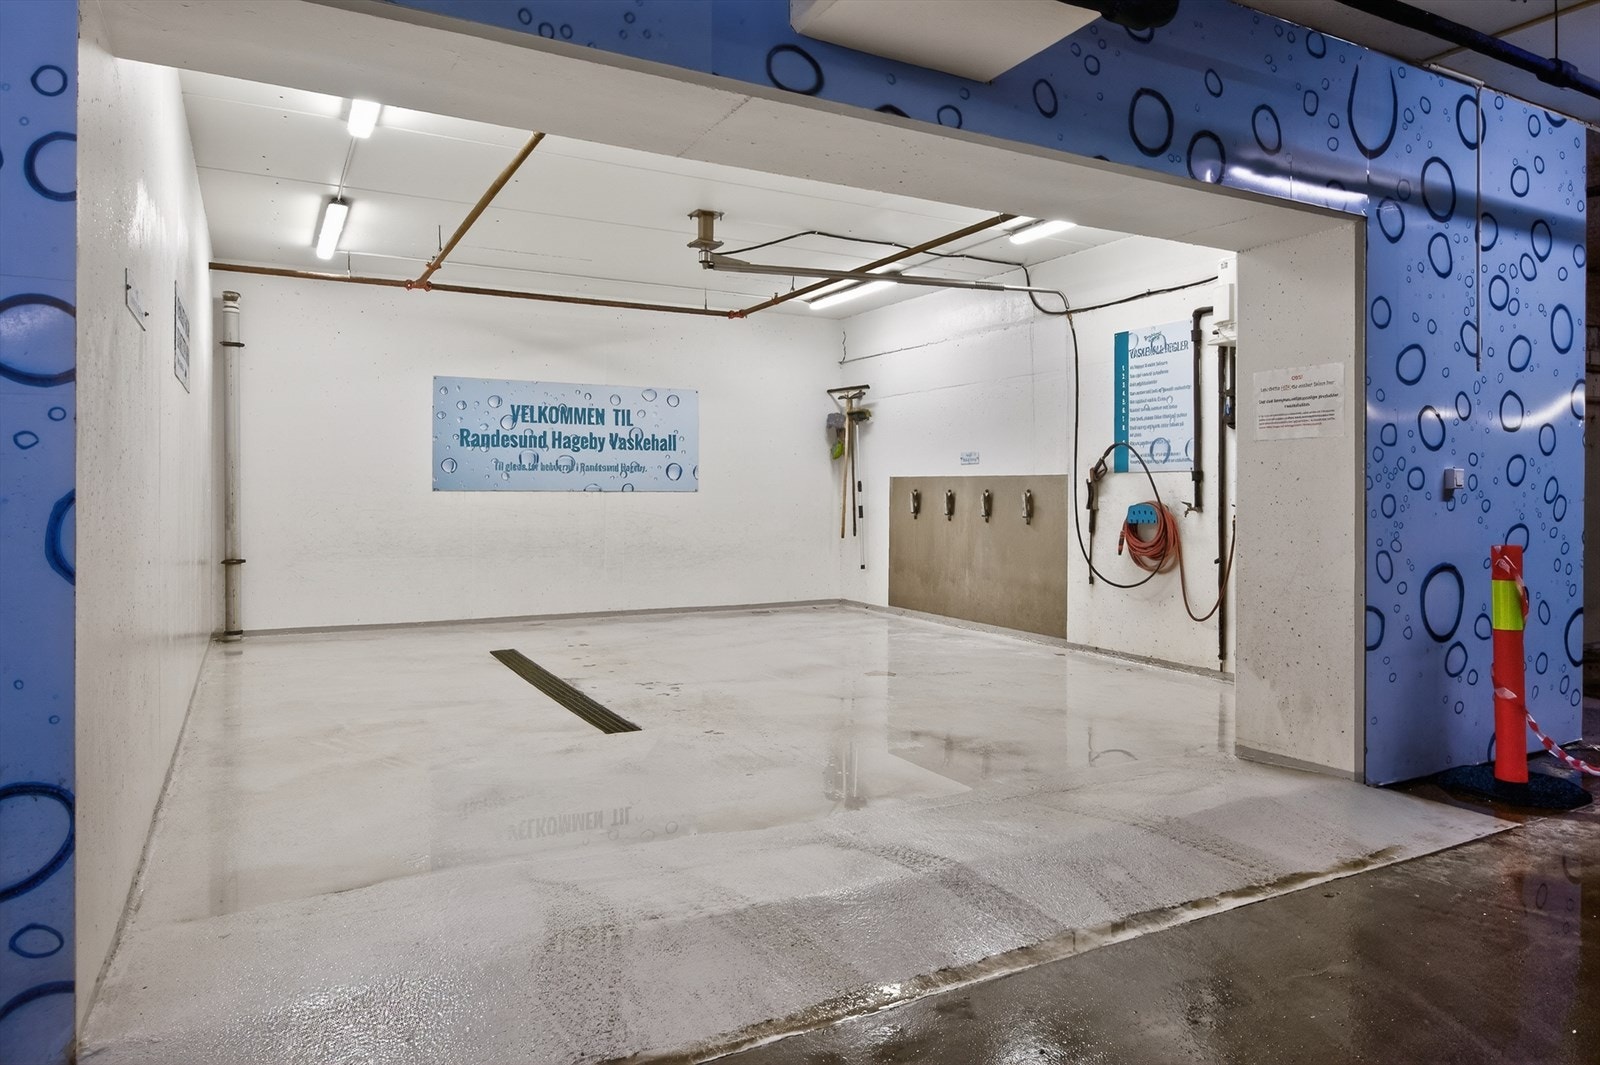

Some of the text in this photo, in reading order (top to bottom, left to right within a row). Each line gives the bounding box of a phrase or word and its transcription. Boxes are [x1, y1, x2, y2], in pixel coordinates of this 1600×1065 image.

[510, 404, 634, 427] VELKOMMEN TIL
[460, 428, 677, 453] Randesund Hageby Vaskehall
